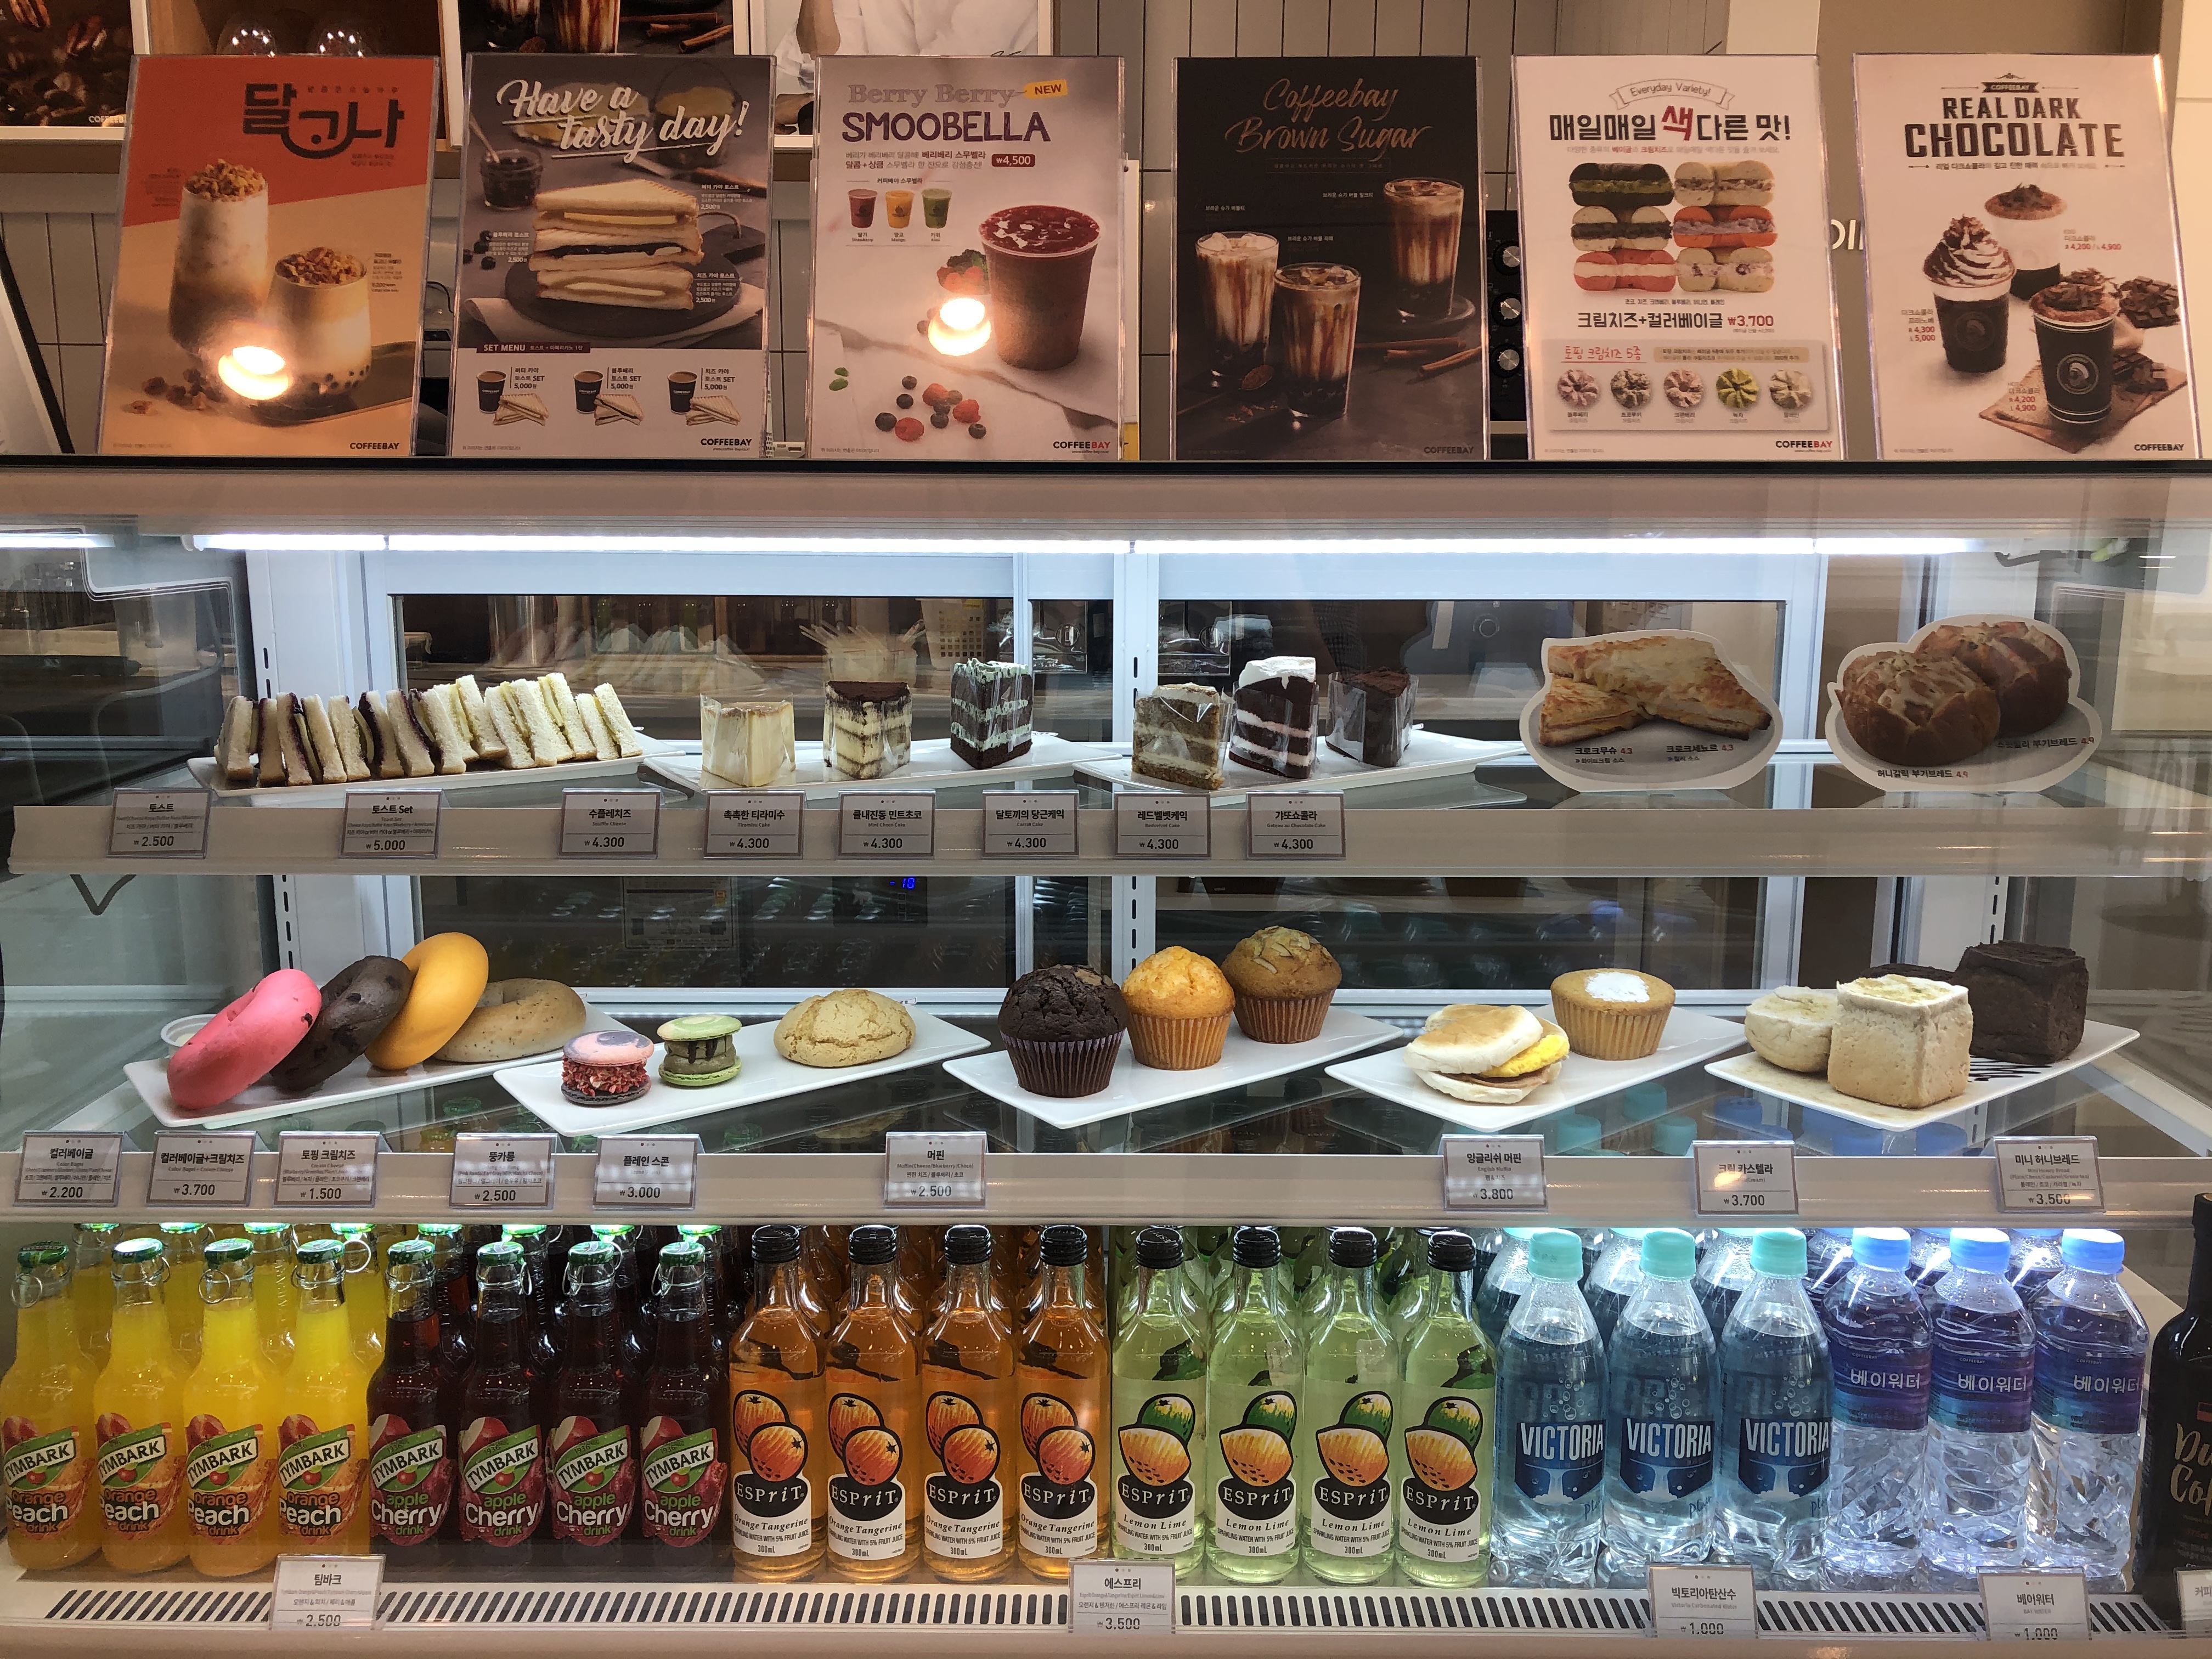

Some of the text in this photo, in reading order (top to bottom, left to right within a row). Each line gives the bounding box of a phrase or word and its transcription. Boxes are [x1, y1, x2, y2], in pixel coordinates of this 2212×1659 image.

[1035, 83, 1062, 94] NEW
[1630, 82, 1712, 97] Everyday Variety!
[496, 80, 639, 117] Have a
[848, 84, 1015, 108] Berry Berry
[1263, 78, 1399, 122] Coffeebay
[1942, 97, 2083, 119] REAL DARK
[842, 111, 1051, 142] SMOOBELLA
[1549, 105, 1791, 142] 매일매일 색다른 맛!
[557, 100, 750, 163] tasty day!
[1224, 116, 1434, 161] Brown Sugar
[1904, 122, 2125, 157] CHOCOLATE
[922, 151, 986, 159] 베리베리 스무벨라
[1578, 312, 1723, 329] 크림치즈+컬러베이글
[1565, 346, 1641, 360] 토핑 크림치즈 5종
[1053, 441, 1111, 449] COFFEEBAY
[1424, 446, 1474, 454] COFFEEBAY
[1775, 440, 1833, 448] COFFEEBAY
[1575, 747, 1617, 755] 크로크무슈
[1877, 769, 1909, 778] 허니갈릭
[148, 803, 175, 812] 토스트
[371, 805, 413, 814] 토스트 Set
[589, 809, 631, 819] 수플레치즈
[724, 810, 785, 820] 촉촉한 티라미수
[853, 809, 922, 820] 쿨내진동 민트초코
[996, 809, 1064, 820] 달토끼의 당근케익
[1137, 811, 1188, 821] 레드벨벳케익
[1275, 810, 1318, 821] 갸또쇼콜라
[141, 836, 174, 847] 2.500
[374, 840, 405, 850] 5.000
[592, 837, 624, 848] 4.300
[736, 837, 769, 849] 4.300
[871, 838, 903, 849] 4.300
[1014, 837, 1047, 848] 4.300
[1147, 839, 1179, 849] 4.300
[1281, 839, 1313, 850] 4.300
[49, 1148, 94, 1159] 컬러베이글
[161, 1153, 245, 1164] 컬러베이글+크림치즈
[301, 1150, 356, 1160] 토핑 크림치즈
[489, 1152, 515, 1162] 뚱카롱
[927, 1149, 945, 1160] 머핀
[1466, 1153, 1521, 1164] 잉글리쉬 머핀
[2015, 1154, 2080, 1165] 미니 허니브레드
[623, 1155, 670, 1167] 플레인 스콘
[1737, 1163, 1774, 1175] 카스텔라
[49, 1187, 83, 1198] 2.200
[181, 1184, 215, 1196] 3.700
[309, 1188, 341, 1199] 1.500
[482, 1190, 516, 1201] 2.500
[627, 1187, 661, 1198] 3.000
[918, 1185, 951, 1197] 2.500
[1480, 1188, 1514, 1200] 3.800
[1731, 1194, 1765, 1206] 3.700
[2036, 1193, 2071, 1205] 3.500
[1850, 1369, 1920, 1390] 베이워터
[1957, 1373, 2027, 1393] 베이워터
[1520, 1423, 1604, 1460] VICTORIA
[1627, 1418, 1711, 1459] VICTORIA
[1745, 1418, 1829, 1457] VICTORIA
[188, 1442, 253, 1482] TYMBARK
[280, 1443, 345, 1482] TYMBARK
[373, 1442, 439, 1482] TYMBARK
[467, 1442, 536, 1486] TYMBARK
[558, 1442, 625, 1485] TYMBARK
[645, 1445, 711, 1483] TYMBARK
[195, 1493, 246, 1509] orange
[386, 1492, 429, 1509] apple
[371, 1499, 442, 1527] Cherry
[465, 1502, 539, 1527] Cherry
[556, 1501, 628, 1527] Cherry
[644, 1499, 714, 1529] Cherry
[395, 1525, 424, 1535] drink
[926, 1514, 1000, 1534] Orange Tangerine
[1226, 1518, 1289, 1531] Lemon Lime
[209, 1525, 240, 1536] drink
[950, 1547, 968, 1555] 300mL
[1248, 1545, 1267, 1554] 300mL
[314, 1573, 342, 1585] 팀바크
[1104, 1577, 1141, 1590] 에스프리
[1672, 1587, 1737, 1600] 빅토리아탄산수
[2017, 1593, 2055, 1606] 베이워터
[306, 1614, 341, 1627] 2.500
[1105, 1617, 1140, 1630] 3.500
[1689, 1622, 1724, 1635] 1.000
